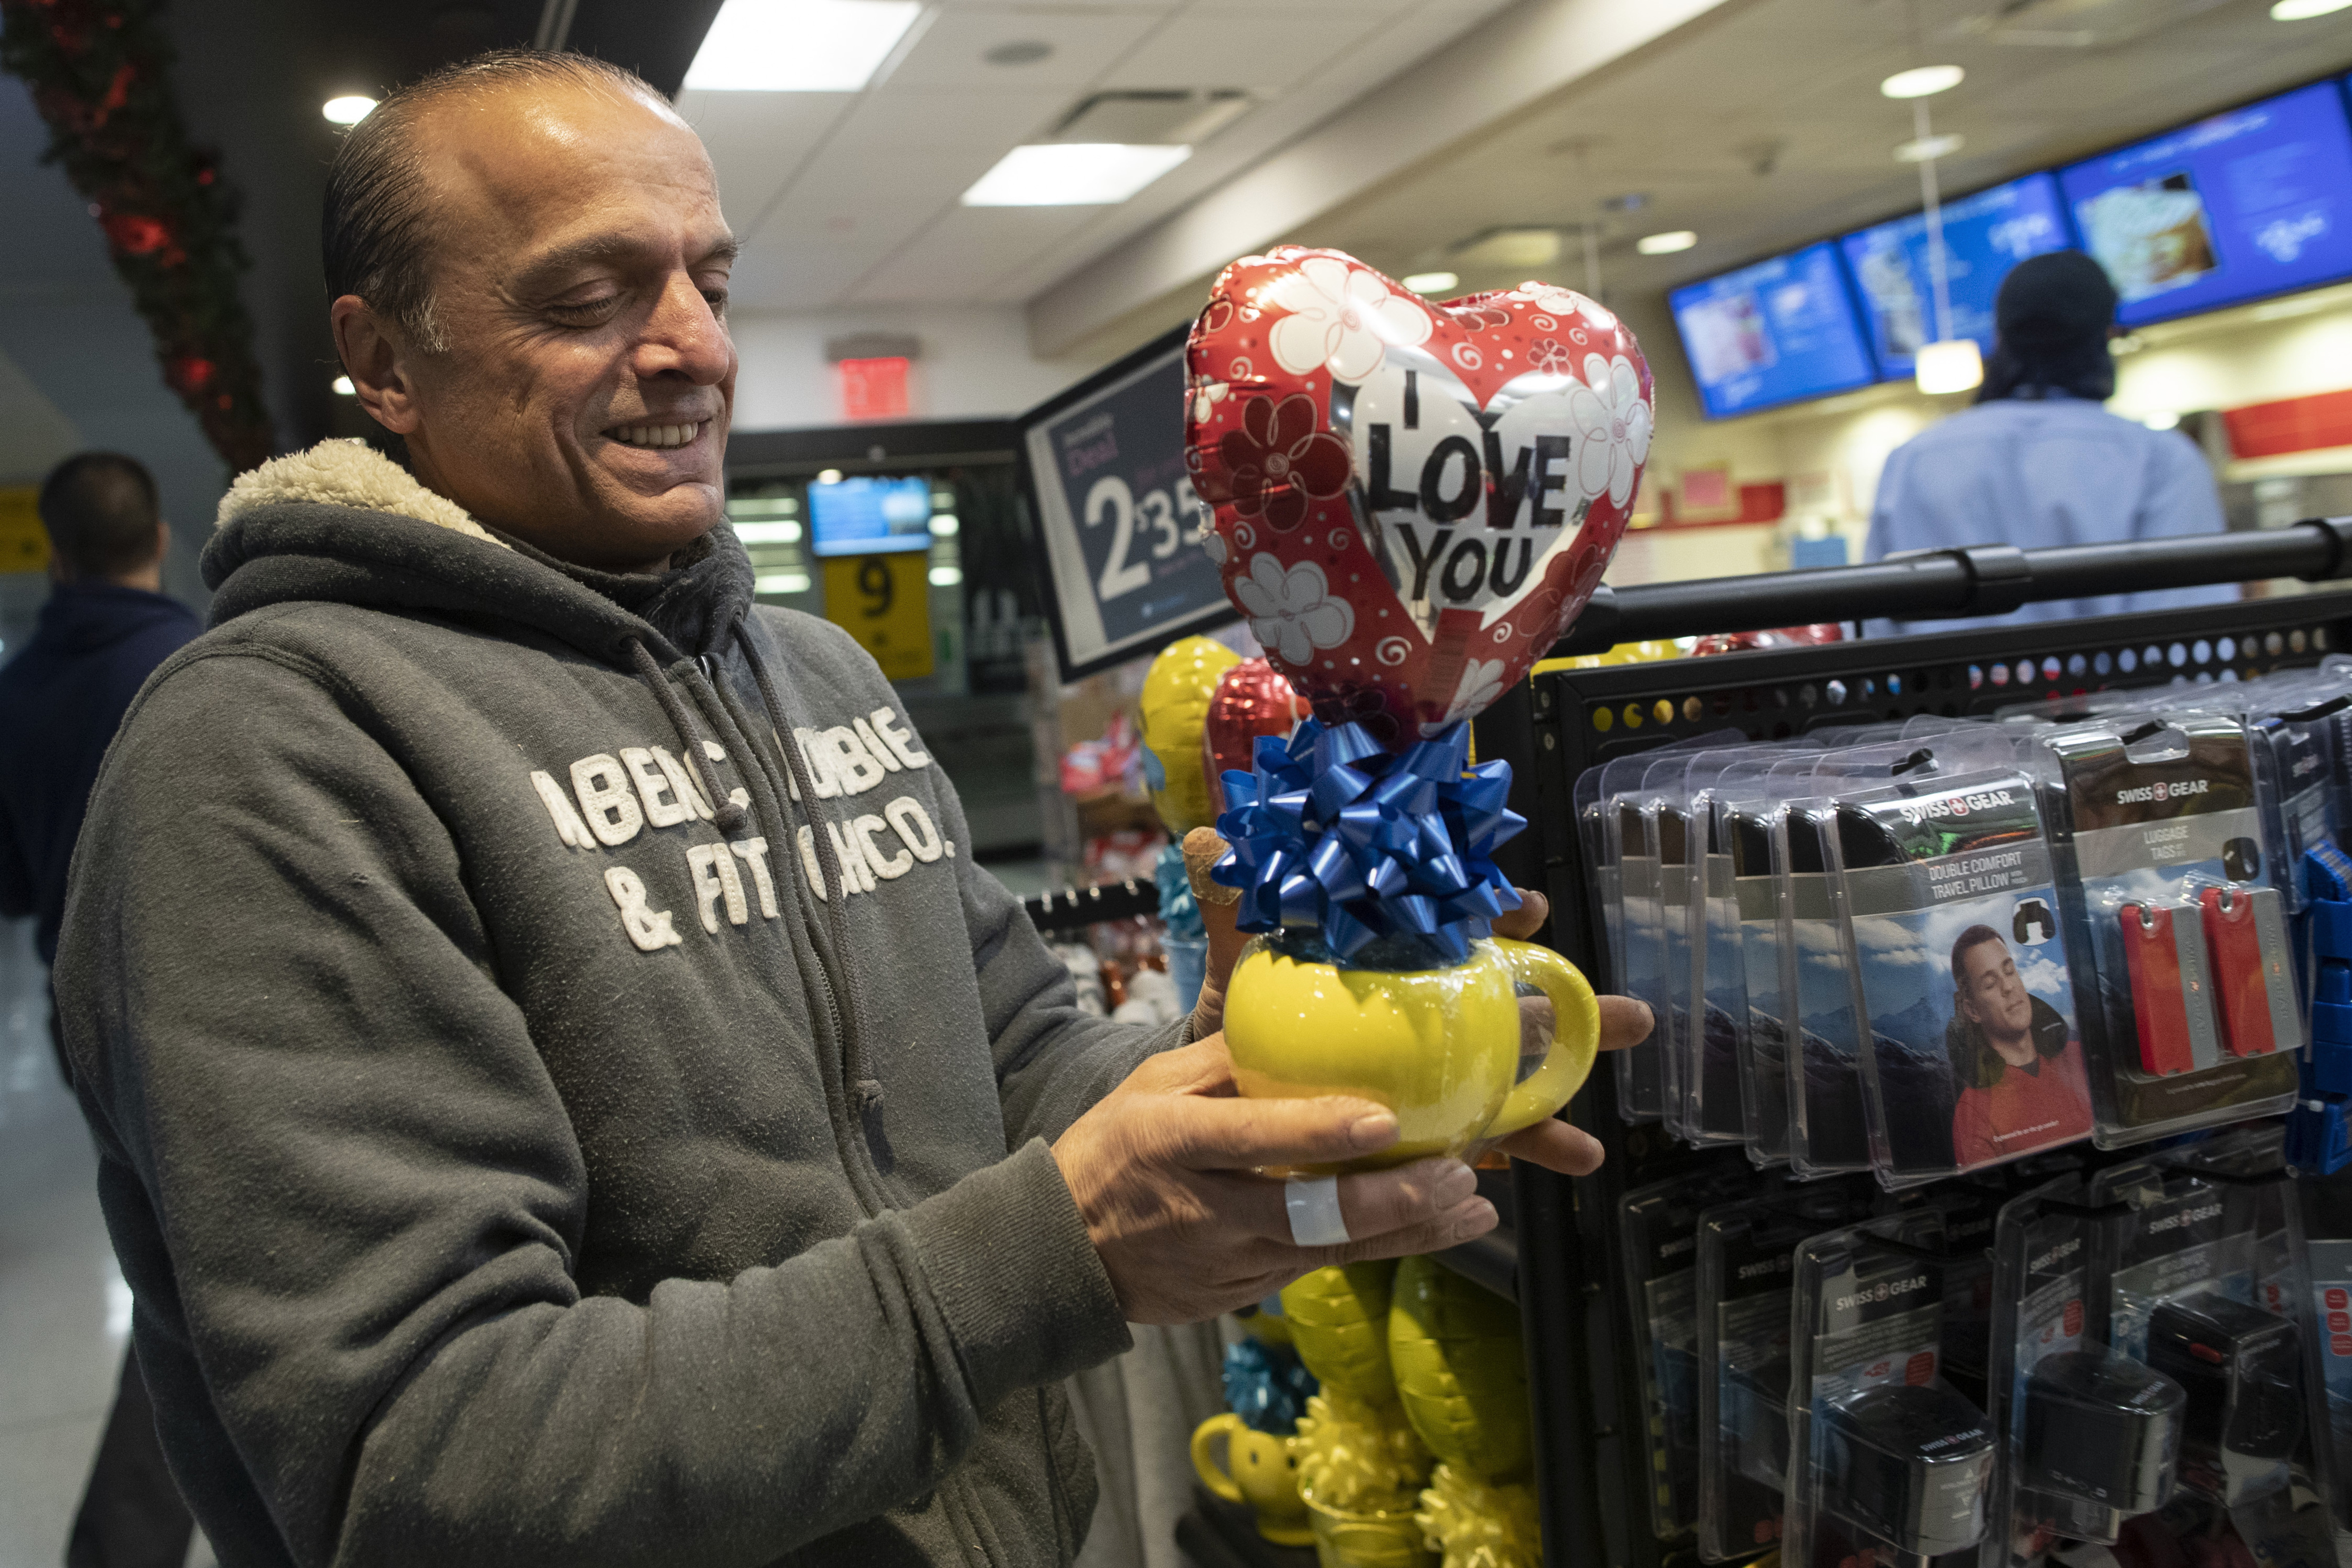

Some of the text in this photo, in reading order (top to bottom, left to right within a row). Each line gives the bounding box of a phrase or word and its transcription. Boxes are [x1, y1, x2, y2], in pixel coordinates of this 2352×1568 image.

[1404, 370, 1419, 429] I
[1369, 424, 1571, 529] LOVE
[859, 556, 893, 617] 9
[1395, 523, 1533, 604] YOU
[1900, 791, 2015, 822] SWISS GEAR
[2117, 779, 2209, 805] SWISS GEAR
[1929, 851, 2022, 881] DOUBLE COMFORT
[1932, 879, 1969, 900] TRAVEL
[1970, 872, 2009, 892] PILLOW
[604, 866, 683, 951] &
[1836, 1275, 1927, 1311] SWISS GEAR
